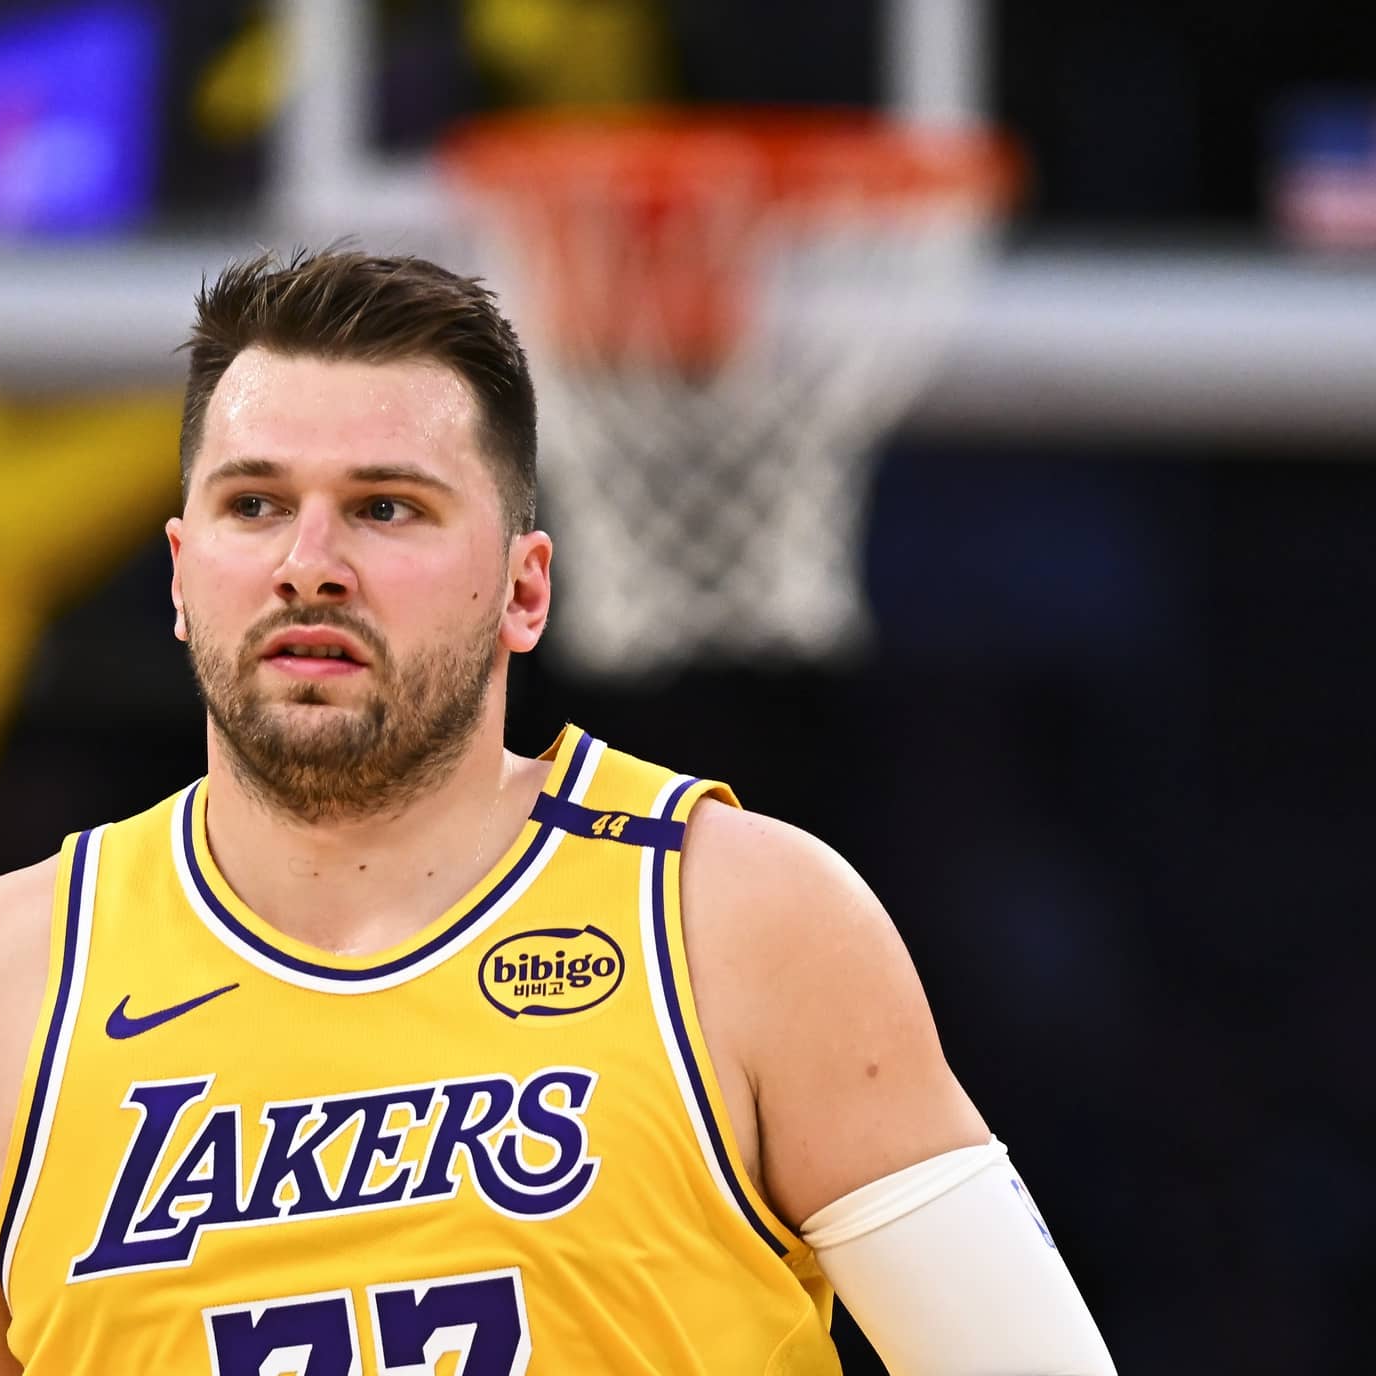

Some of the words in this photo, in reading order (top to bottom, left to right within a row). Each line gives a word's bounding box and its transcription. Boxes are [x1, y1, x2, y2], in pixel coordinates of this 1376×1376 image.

[591, 815, 629, 837] 44
[493, 949, 616, 988] bibigo
[513, 981, 565, 997] 비비고
[66, 1066, 601, 1284] LAKERS
